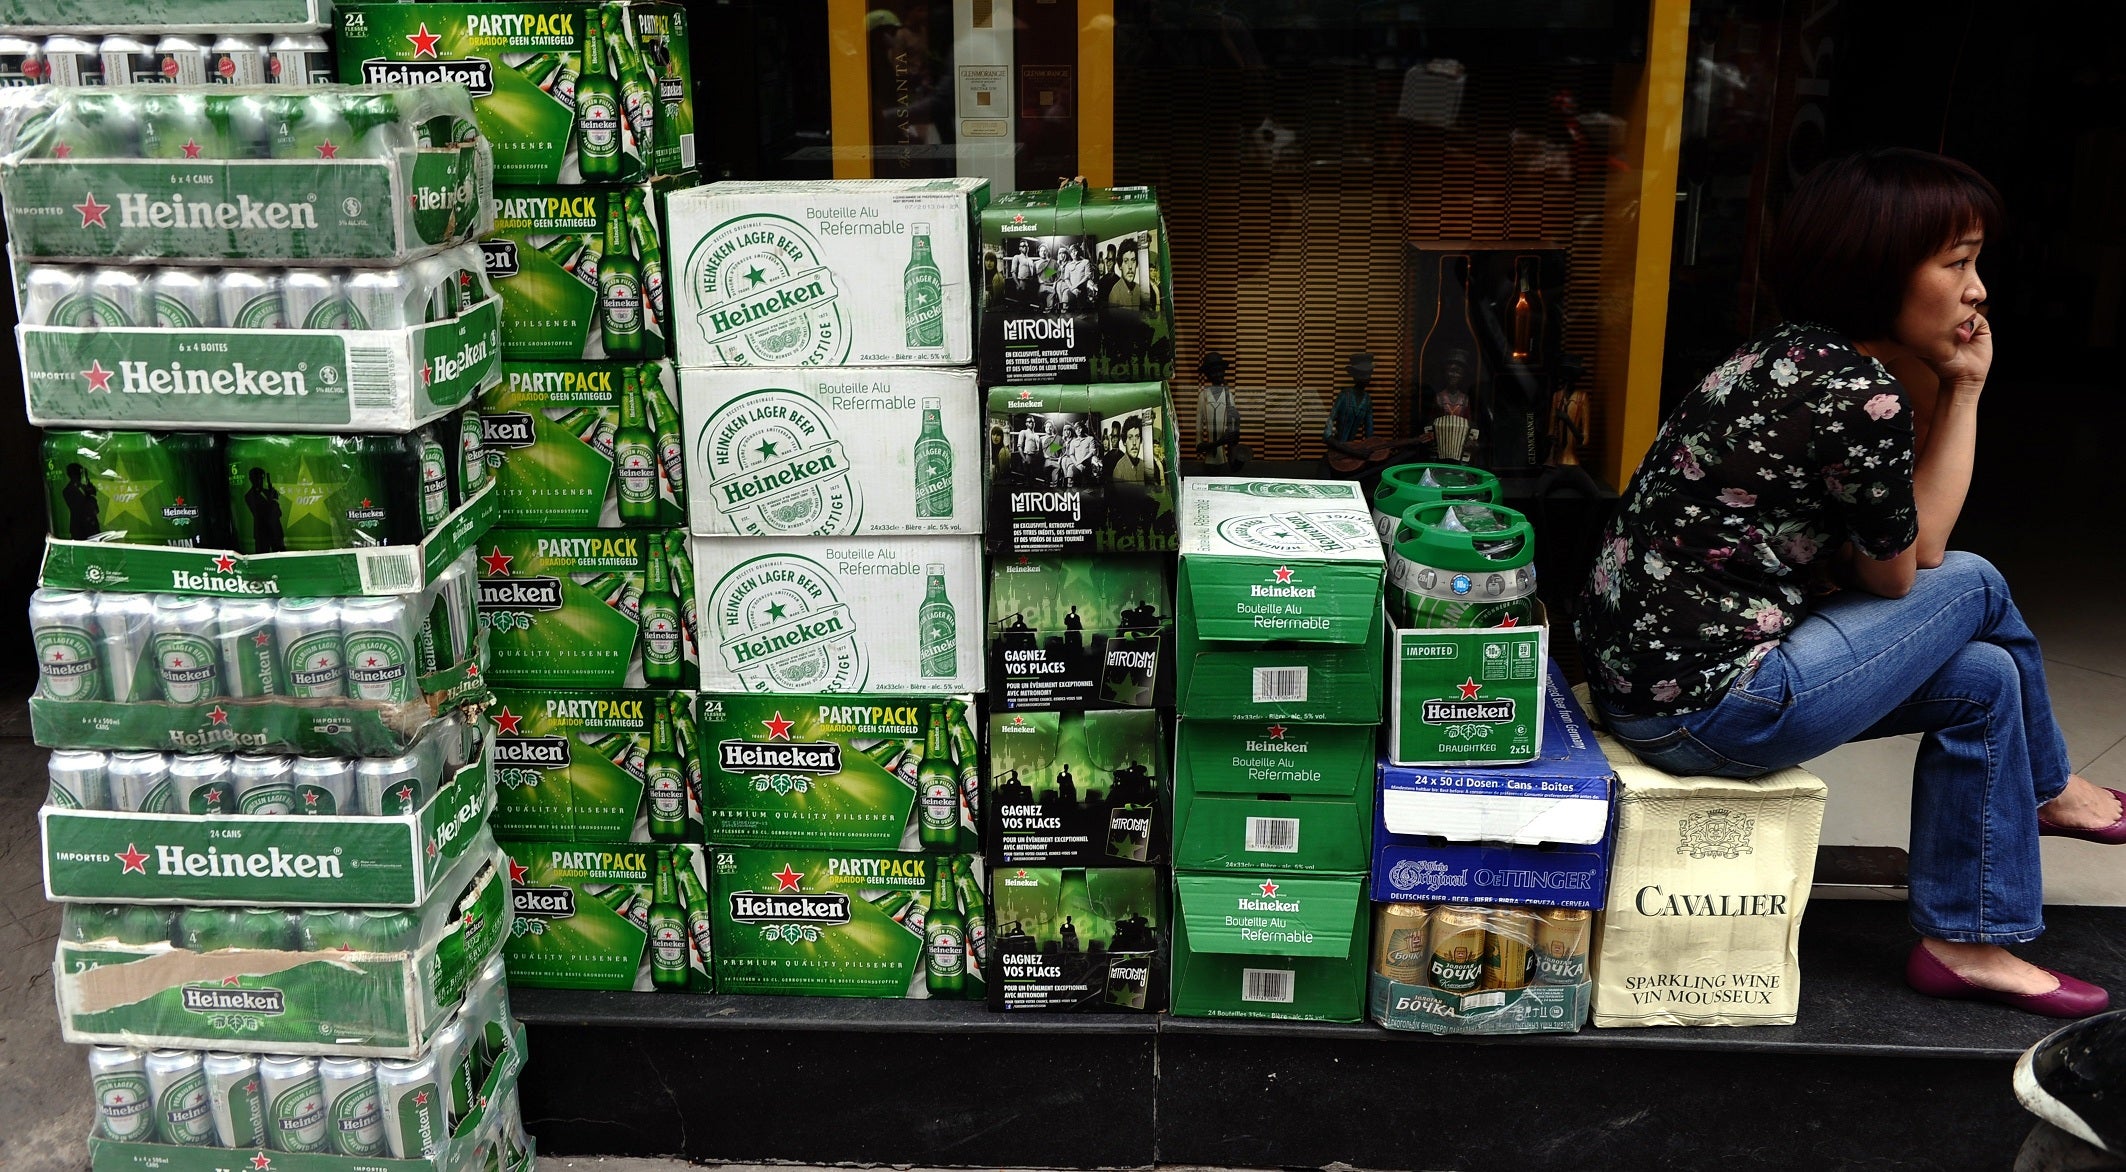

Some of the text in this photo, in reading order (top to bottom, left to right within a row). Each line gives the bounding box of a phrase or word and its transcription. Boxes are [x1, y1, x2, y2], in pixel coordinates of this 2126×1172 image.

[345, 14, 364, 27] 24
[467, 14, 573, 36] PARTYPACK
[510, 37, 529, 45] GEEN
[531, 36, 574, 45] STATIEGELD
[369, 66, 486, 88] Heineken
[896, 52, 910, 143] LASANTA
[193, 174, 214, 184] CANS
[12, 193, 318, 230] IMPORTED Heineken
[807, 207, 879, 219] Bouteille Alu
[555, 219, 596, 227] STATIEGELD
[820, 221, 904, 235] Refermable
[1001, 224, 1037, 233] Heineken
[705, 241, 736, 294] HEINEKEN
[736, 232, 774, 251] LAGER
[777, 236, 804, 262] BEER
[710, 279, 825, 334] Heineken
[201, 343, 228, 352] BOITES
[119, 361, 308, 396] Heineken
[510, 372, 612, 392] PARTYPACK
[820, 383, 890, 394] Bouteille Alu
[571, 392, 612, 400] STATIEGELD
[832, 397, 915, 410] Refermable
[1008, 400, 1043, 408] Heineken
[717, 406, 815, 465] HEINEKEN LAGER BEER
[722, 453, 837, 504] Heineken
[163, 508, 197, 516] Heineken
[349, 510, 384, 519] Heineken
[538, 539, 637, 557] PARTYPACK
[826, 549, 895, 560] Bouteille Alu
[598, 558, 638, 566] STATIEGELD
[839, 562, 920, 575] Refermable
[172, 570, 279, 593] Heineken
[727, 570, 823, 626] HEINEKEN LAGER BEER
[1251, 585, 1315, 598] Heineken
[1237, 603, 1301, 614] Bouteille Alu
[1254, 615, 1330, 629] Refermable
[732, 614, 844, 663] Heineken
[1005, 650, 1046, 661] GAGNEZ
[1406, 647, 1453, 656] IMPORTED
[1005, 662, 1065, 675] VOS PLACES
[547, 700, 643, 718] PARTYPACK
[705, 702, 722, 712] 24
[1427, 704, 1510, 720] Heineken
[819, 706, 918, 726] PARTYPACK
[605, 719, 643, 727] STATIEGELD
[858, 725, 918, 734] GEEN STATIEGELD
[1552, 696, 1586, 750] Beer from Germany
[1246, 741, 1308, 753] Heineken
[1510, 745, 1530, 754] 2x5L
[726, 746, 835, 767] Heineken
[1233, 757, 1294, 768] Bouteille Alu
[1249, 768, 1321, 782] Refermable
[1415, 776, 1427, 784] 24
[1440, 777, 1452, 786] 50
[1455, 778, 1463, 786] cl
[1467, 778, 1498, 788] Dosen
[1507, 780, 1532, 789] Cans
[1542, 782, 1573, 791] Boîtes
[712, 810, 895, 821] PREMIUM QUALITY PILSENER
[1001, 805, 1042, 816] GAGNEZ
[1002, 818, 1061, 828] VOS PLACES
[210, 830, 242, 838] 24 CANS
[56, 845, 343, 878] IMPORTED Heineken
[552, 852, 646, 870] PARTYPACK
[717, 855, 734, 865] 24
[829, 858, 925, 877] PARTYPACK
[609, 871, 647, 879] STATIEGELD
[867, 877, 925, 886] GEEN STATIEGELD
[736, 897, 844, 918] Heineken
[1238, 899, 1299, 912] Heineken
[1635, 885, 1787, 917] CAVALIER
[1226, 916, 1287, 928] Bouteille Alu
[1242, 928, 1313, 943] Refermable
[1003, 954, 1042, 965] GAGNEZ
[1003, 966, 1061, 977] VOS PLACES
[1626, 974, 1780, 990] SPARKLING WINE
[187, 991, 279, 1010] Heineken
[1632, 990, 1772, 1005] VIN MOUSSEUX
